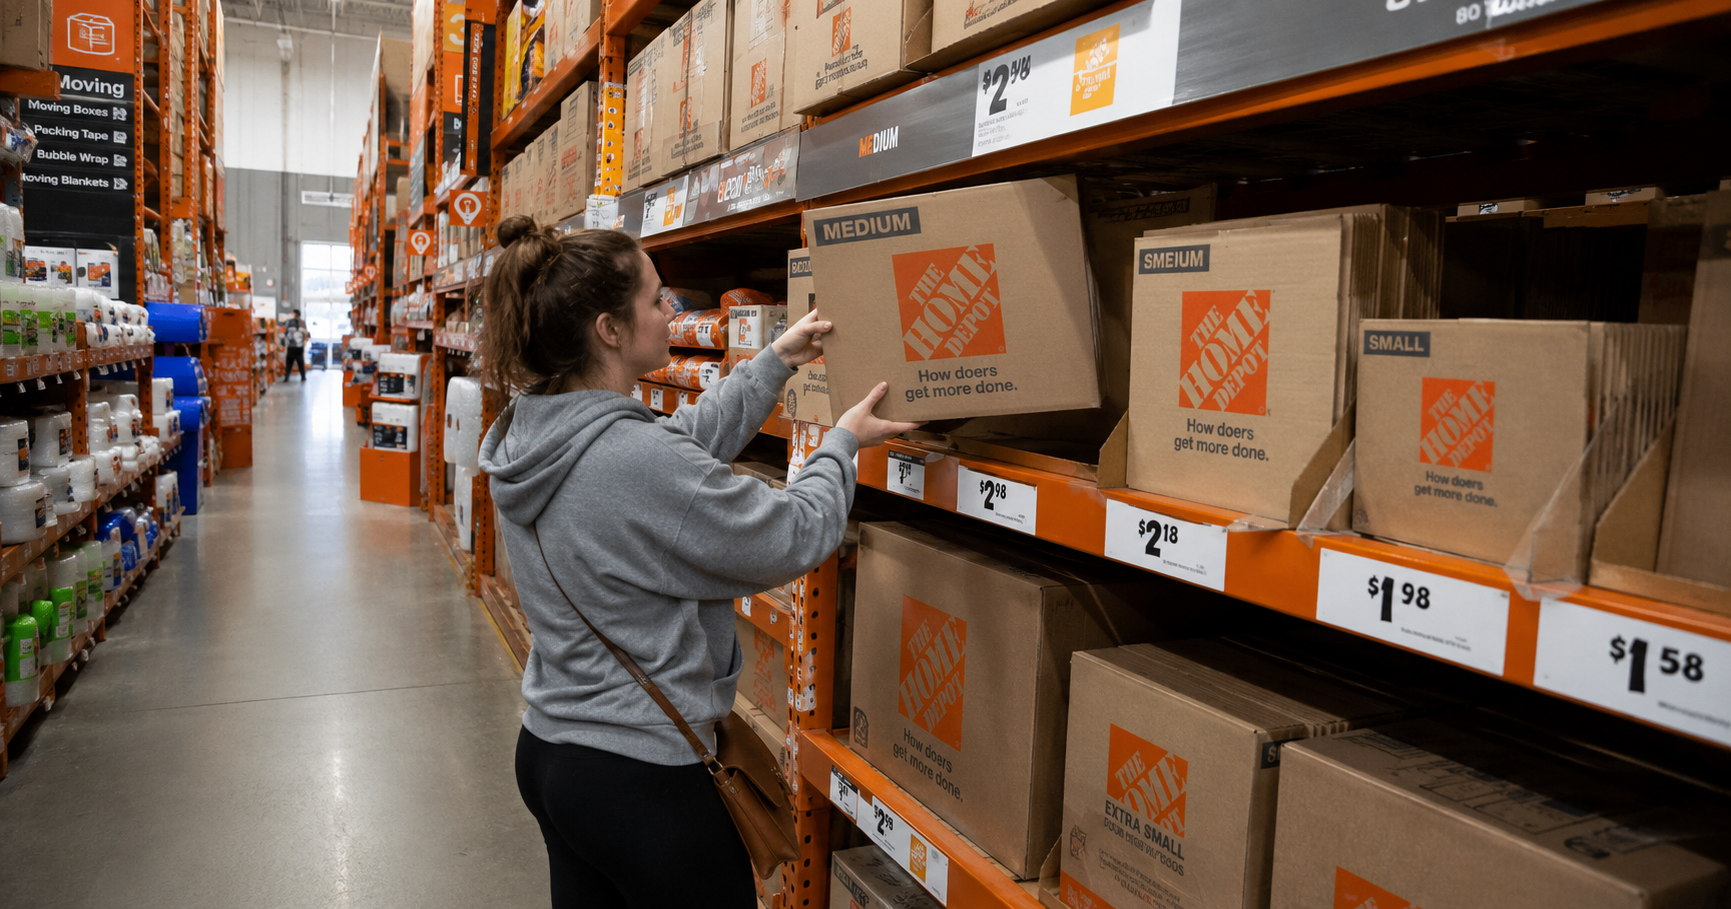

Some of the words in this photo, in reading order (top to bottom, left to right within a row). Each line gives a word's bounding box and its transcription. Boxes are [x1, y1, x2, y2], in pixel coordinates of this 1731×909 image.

[60, 74, 125, 99] Moving
[28, 99, 71, 115] Moving
[73, 104, 109, 117] Boxes
[81, 129, 109, 141] Tape
[859, 125, 899, 158] MEDIUM
[37, 149, 77, 162] Bubble
[79, 152, 109, 166] Wrap
[61, 175, 109, 188] Blankets
[822, 212, 912, 241] MEDIUM
[1143, 249, 1204, 269] SMEIUM
[902, 244, 997, 361] HOME
[908, 262, 946, 307] THE
[944, 287, 1000, 358] DEPOT
[1190, 304, 1224, 351] THE
[1179, 289, 1271, 409] HOME
[1369, 334, 1425, 352] SMALL
[905, 385, 931, 402] get
[933, 383, 972, 397] more
[974, 380, 1018, 395] done.
[918, 368, 952, 383] How
[954, 365, 998, 380] doers
[1212, 340, 1269, 412] DEPOT
[1420, 379, 1495, 464] HOME
[1428, 388, 1458, 421] THE
[1186, 418, 1214, 435] How
[1217, 421, 1254, 441] doers
[1448, 416, 1494, 468] DEPOT
[1174, 435, 1194, 451] get
[1196, 437, 1229, 455] more
[1232, 442, 1269, 462] done.
[979, 479, 1007, 511] $298
[1414, 484, 1432, 496] get
[1434, 487, 1462, 501] more
[1465, 491, 1498, 508] done.
[1426, 470, 1449, 486] How
[1452, 474, 1484, 491] doers
[1138, 518, 1178, 558] $218
[907, 618, 933, 661] THE
[899, 615, 966, 720] HOME
[922, 670, 965, 733] DEPOT
[903, 727, 924, 754] How
[925, 743, 953, 774] doers
[893, 741, 909, 760] get
[909, 752, 934, 780] more
[935, 774, 964, 803] done.
[1114, 750, 1147, 791] THE
[1119, 753, 1186, 820] OME
[1105, 799, 1141, 835] EXTRA
[1143, 823, 1185, 862] SMALL
